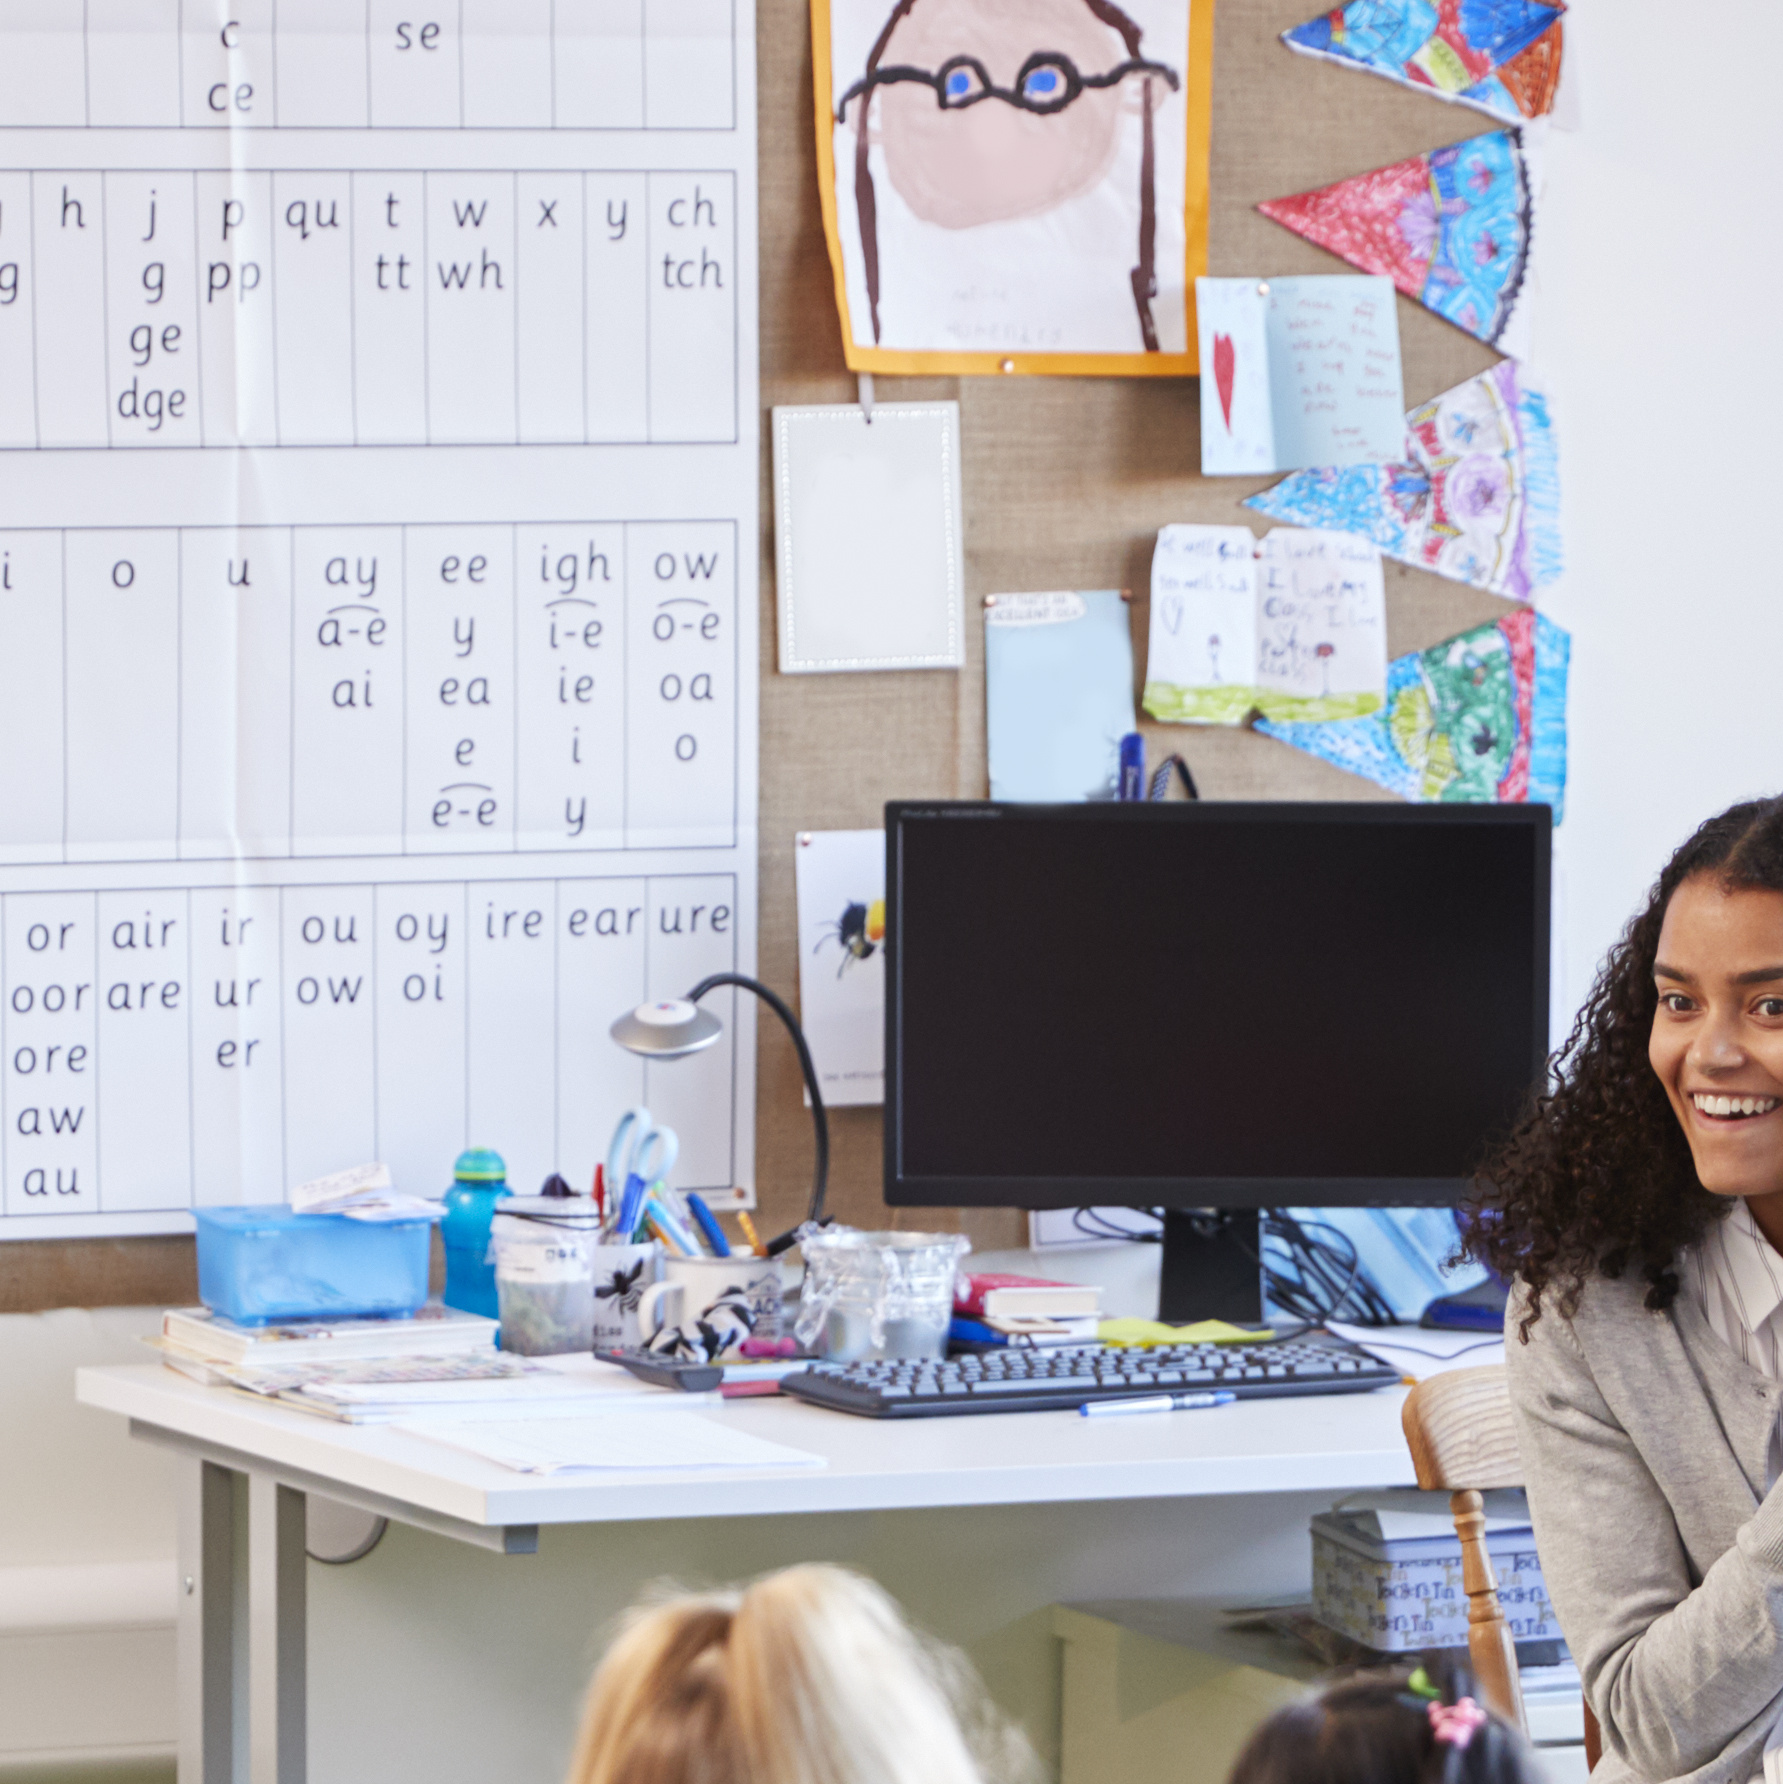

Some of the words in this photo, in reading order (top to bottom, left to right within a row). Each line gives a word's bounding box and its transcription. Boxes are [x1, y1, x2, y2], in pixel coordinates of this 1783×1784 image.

[395, 21, 441, 51] se
[207, 82, 254, 113] ce
[61, 186, 85, 229] h
[142, 189, 157, 243] j
[221, 200, 244, 242] p
[285, 200, 339, 241] qu
[386, 193, 399, 228] t
[453, 201, 487, 228] w
[538, 201, 557, 227] x
[607, 201, 627, 241] y
[667, 186, 716, 228] ch
[142, 262, 165, 305] g
[207, 261, 261, 304] pp
[376, 255, 409, 290] tt
[438, 248, 503, 290] wh
[662, 248, 723, 289] tch
[129, 324, 182, 367] ge
[117, 376, 186, 432] dge
[2, 551, 12, 591] i
[111, 559, 136, 589] o
[228, 559, 251, 587] u
[324, 557, 377, 598] ay
[440, 555, 488, 584] ee
[541, 541, 611, 595] igh
[654, 553, 718, 581] ow
[317, 618, 387, 647] a-e
[454, 618, 475, 658] y
[332, 670, 373, 709] ai
[439, 677, 491, 706] ea
[558, 666, 594, 704] ie
[659, 673, 714, 702] oa
[454, 738, 475, 767] e
[571, 726, 582, 765] i
[674, 733, 698, 763] o
[431, 798, 497, 828] e-e
[565, 798, 586, 836] y
[27, 922, 74, 952] or
[111, 911, 175, 950] air
[220, 908, 252, 947] ir
[301, 916, 357, 944] ou
[395, 914, 448, 954] oy
[486, 902, 543, 940] ire
[568, 907, 641, 937] ear
[660, 904, 731, 935] ure
[11, 983, 90, 1014] oor
[107, 981, 181, 1011] are
[214, 979, 260, 1008] ur
[296, 977, 362, 1005] ow
[402, 963, 444, 1003] oi
[13, 1045, 88, 1075] ore
[216, 1039, 259, 1069] er
[17, 1107, 84, 1136] aw
[23, 1168, 80, 1197] au
